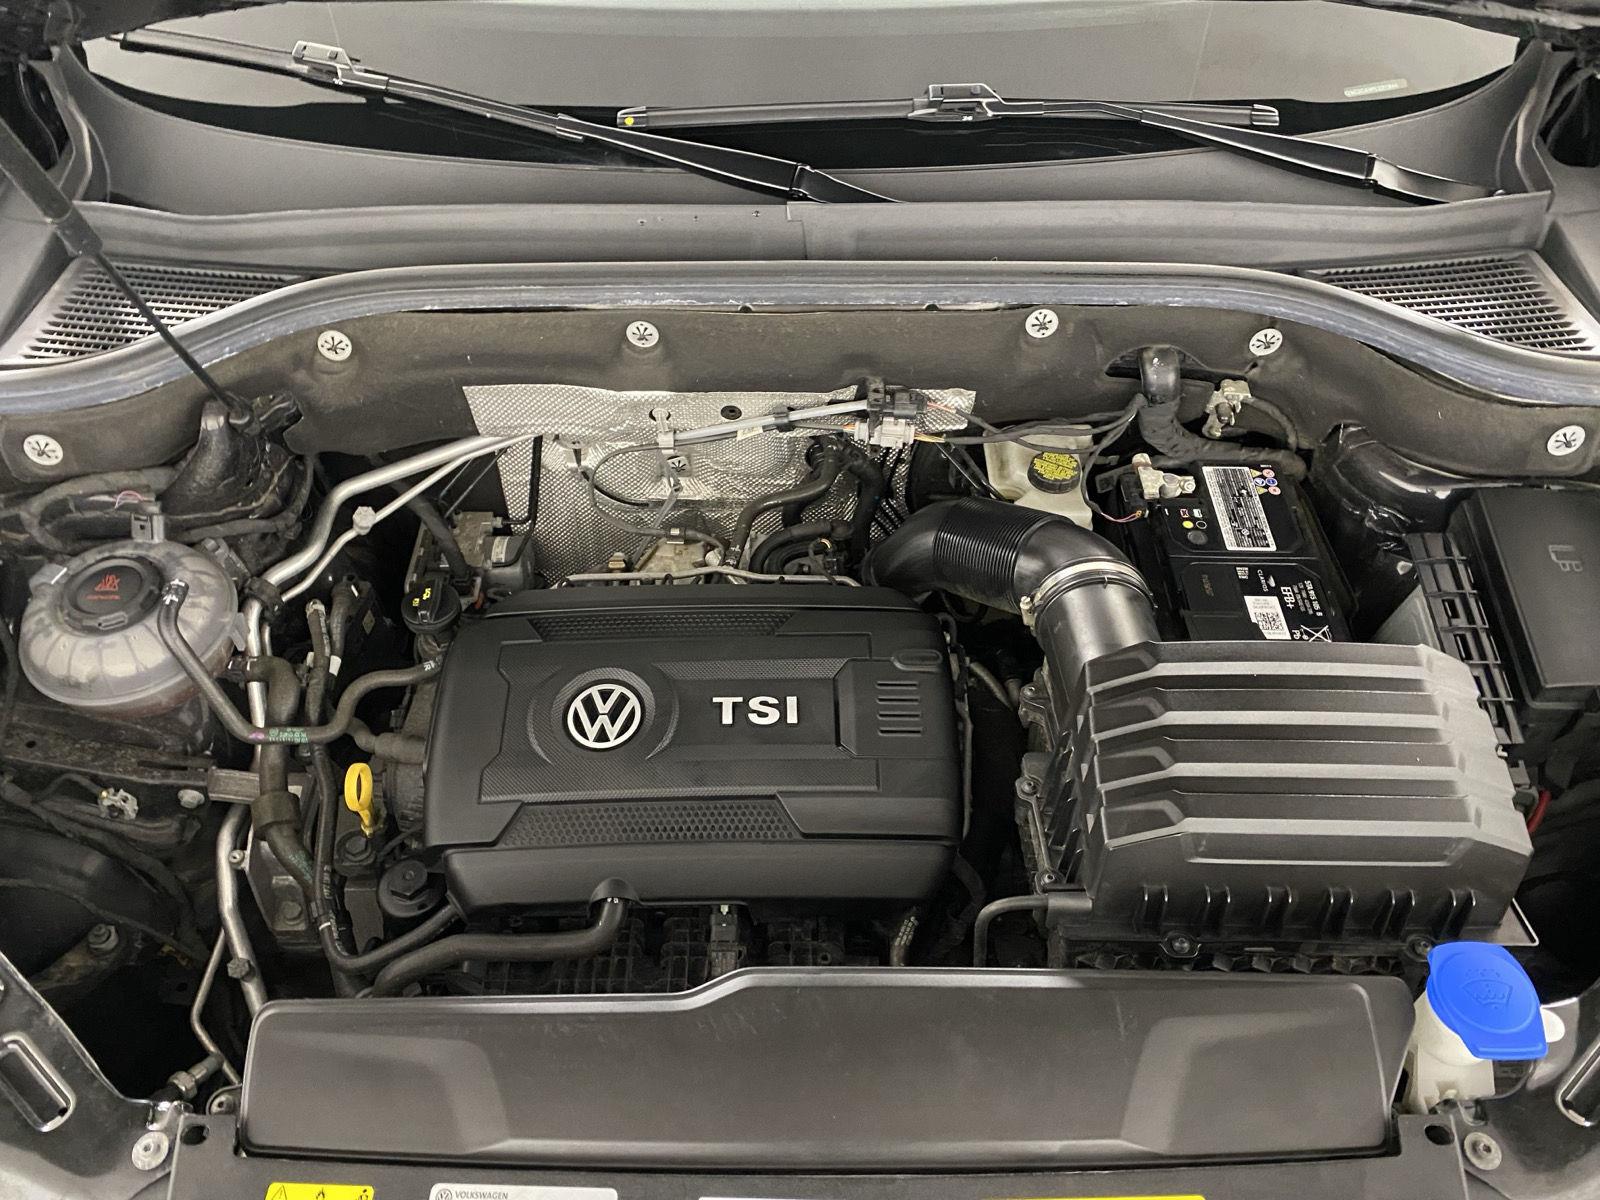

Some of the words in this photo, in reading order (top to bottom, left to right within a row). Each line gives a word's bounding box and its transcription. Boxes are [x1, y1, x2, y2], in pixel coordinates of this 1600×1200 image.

[1257, 569, 1268, 592] CLARIOS
[1280, 586, 1296, 610] EFB+
[567, 683, 642, 749] VW
[712, 696, 798, 725] TSI
[455, 1190, 509, 1200] VOLKSWAGEN
